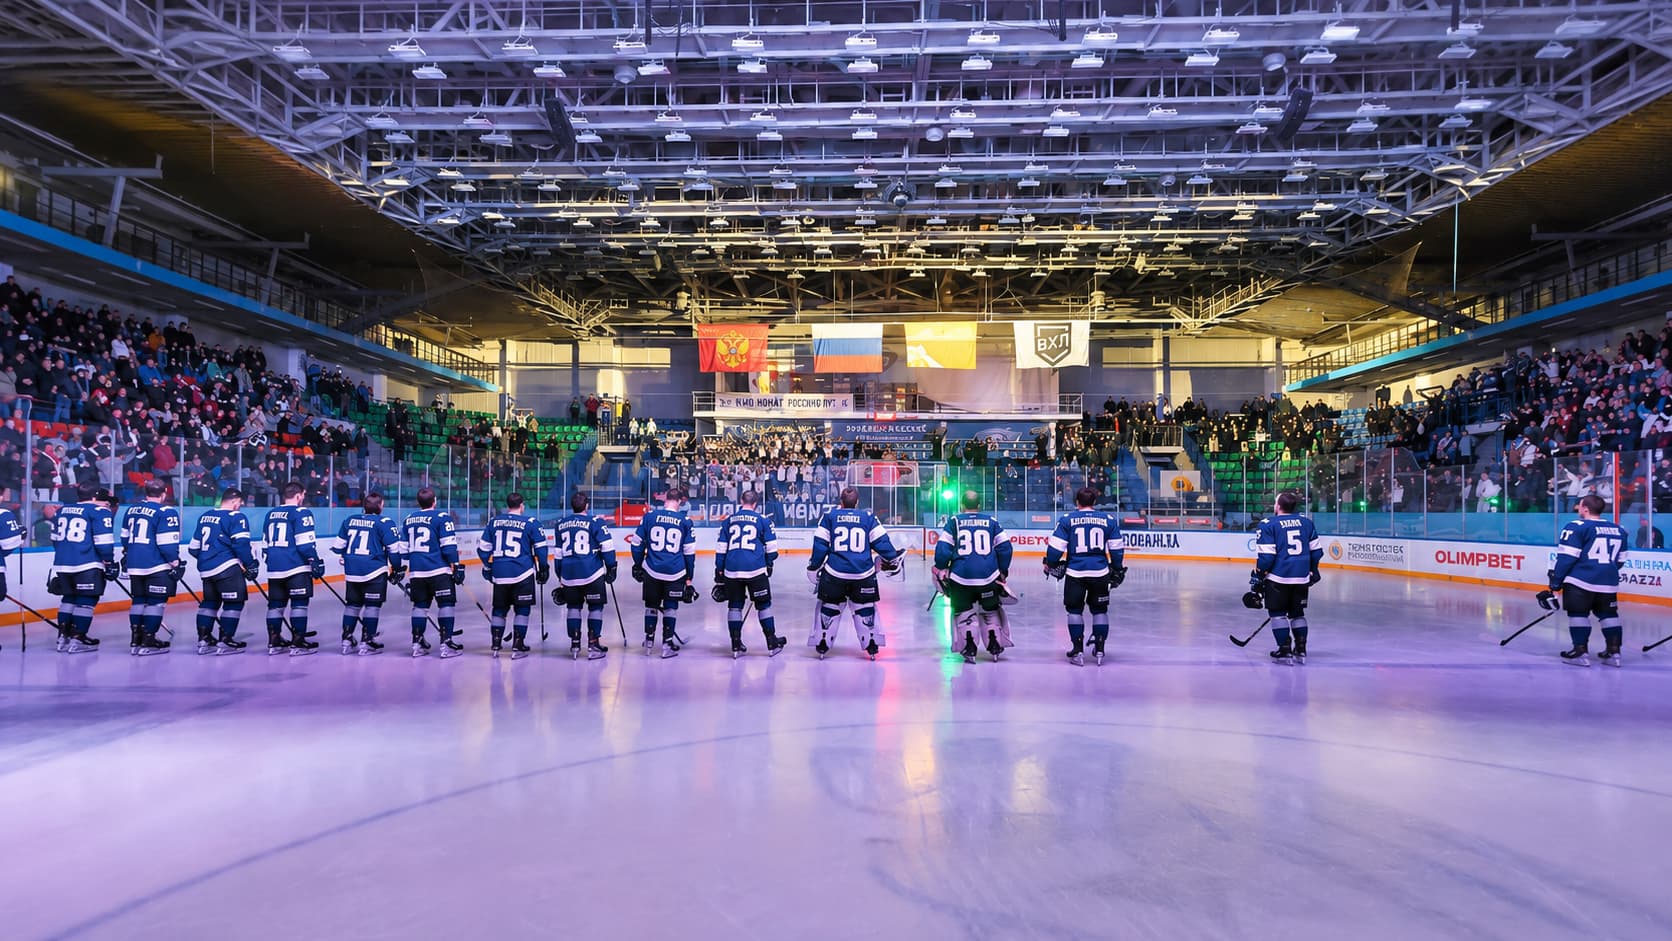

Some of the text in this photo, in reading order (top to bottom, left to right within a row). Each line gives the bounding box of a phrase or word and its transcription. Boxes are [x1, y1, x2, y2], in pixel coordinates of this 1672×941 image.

[1037, 332, 1069, 351] ВХЛ
[347, 528, 370, 555] 71
[493, 530, 522, 558] 15
[650, 526, 682, 554] 99
[729, 525, 757, 551] 22
[834, 526, 866, 553] 20
[957, 529, 991, 556] 30
[1075, 527, 1105, 554] 10
[1287, 530, 1302, 555] 5
[1588, 537, 1622, 564] 47
[1435, 550, 1525, 571] OLIMPBET
